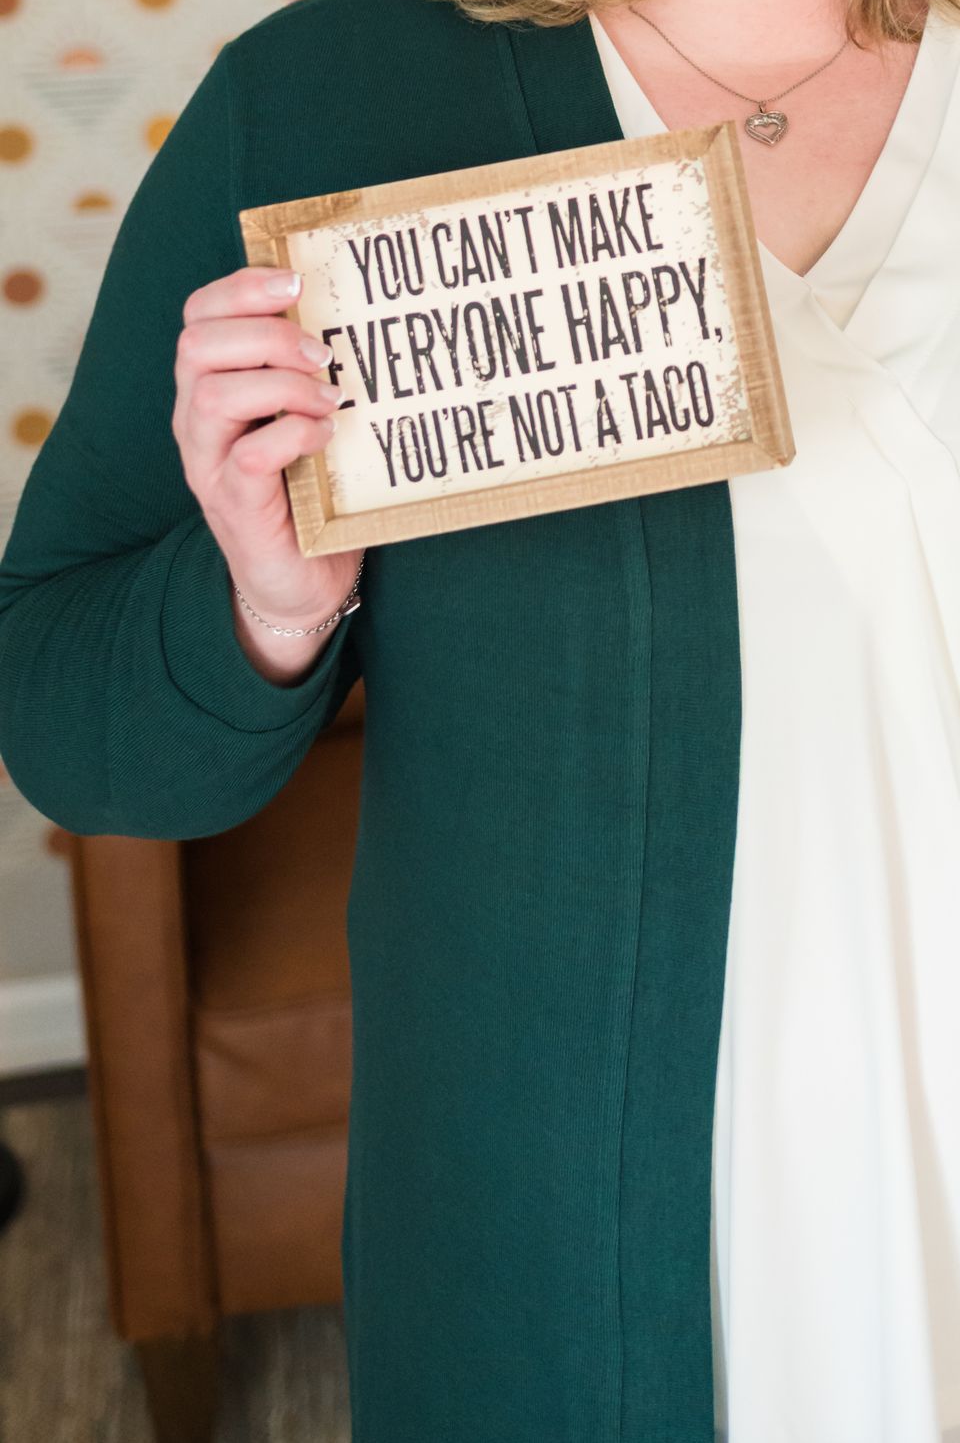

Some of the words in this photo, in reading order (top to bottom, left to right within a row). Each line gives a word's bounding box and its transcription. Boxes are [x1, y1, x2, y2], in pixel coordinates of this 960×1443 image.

[348, 230, 425, 305] YOU
[432, 206, 539, 289] CAN'T
[546, 183, 663, 268] MAKE
[322, 288, 556, 410] EVERYONE
[560, 257, 723, 365] HAPPY,
[370, 399, 505, 487] YOU'RE
[508, 383, 583, 459] NOT
[594, 378, 622, 448] A
[620, 360, 715, 441] TACO
